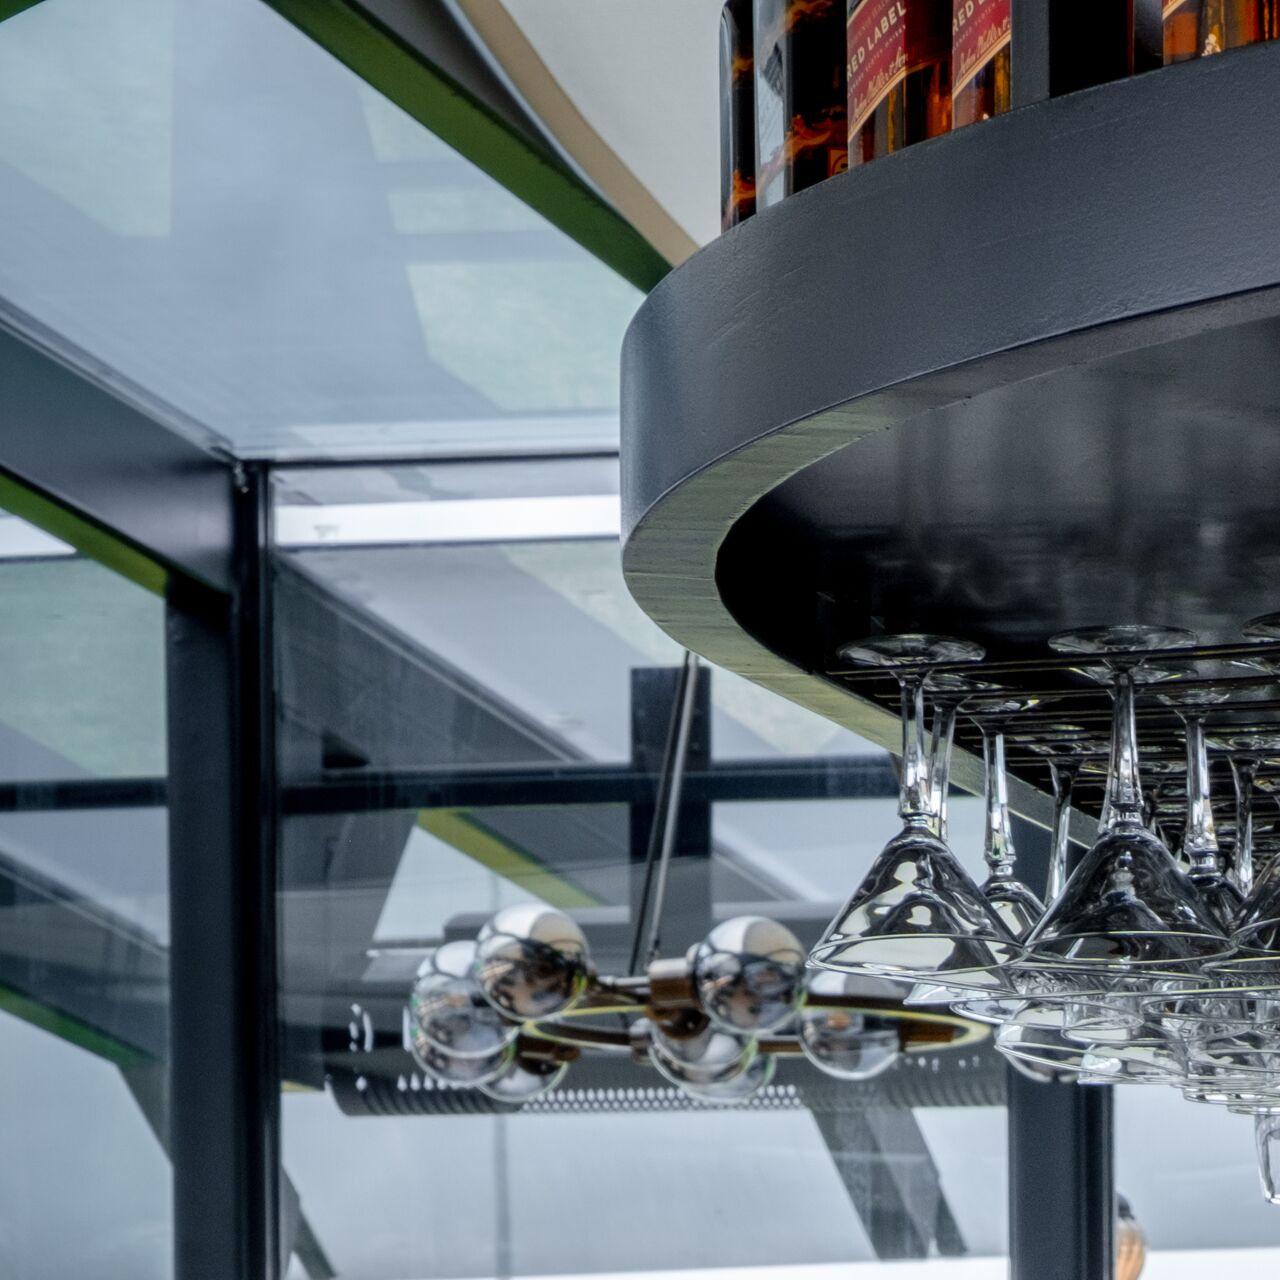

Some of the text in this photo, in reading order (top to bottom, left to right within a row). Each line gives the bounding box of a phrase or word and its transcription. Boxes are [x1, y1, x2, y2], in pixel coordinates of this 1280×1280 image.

[847, 47, 866, 78] RED
[867, 1, 907, 51] LABEL
[952, 1, 975, 34] RED
